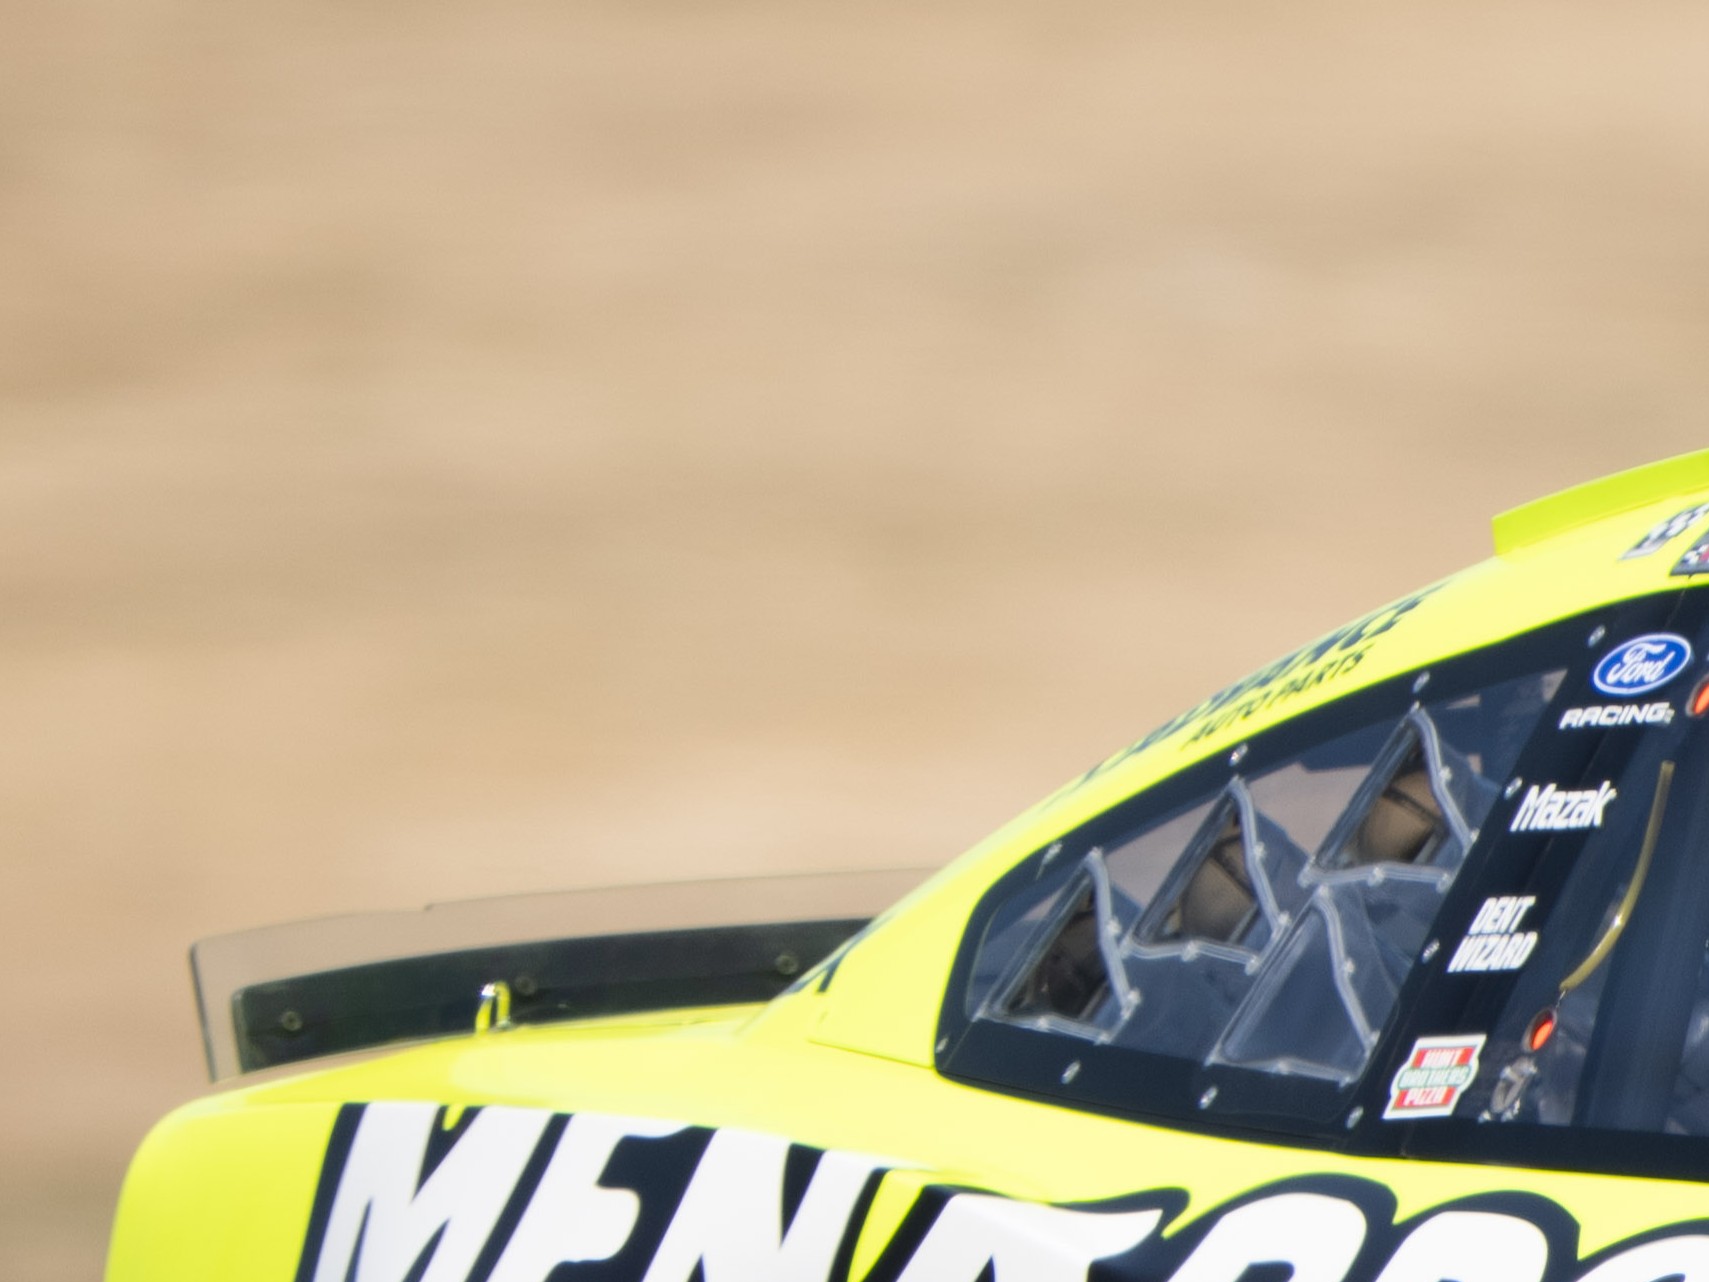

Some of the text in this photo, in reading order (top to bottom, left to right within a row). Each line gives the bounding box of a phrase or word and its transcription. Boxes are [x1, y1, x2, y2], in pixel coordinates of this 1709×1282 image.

[1606, 642, 1676, 685] Ford
[1558, 701, 1671, 730] RACING
[1509, 780, 1617, 833] Mazak
[1467, 895, 1537, 936] DENT
[1446, 930, 1539, 974] WIZARD
